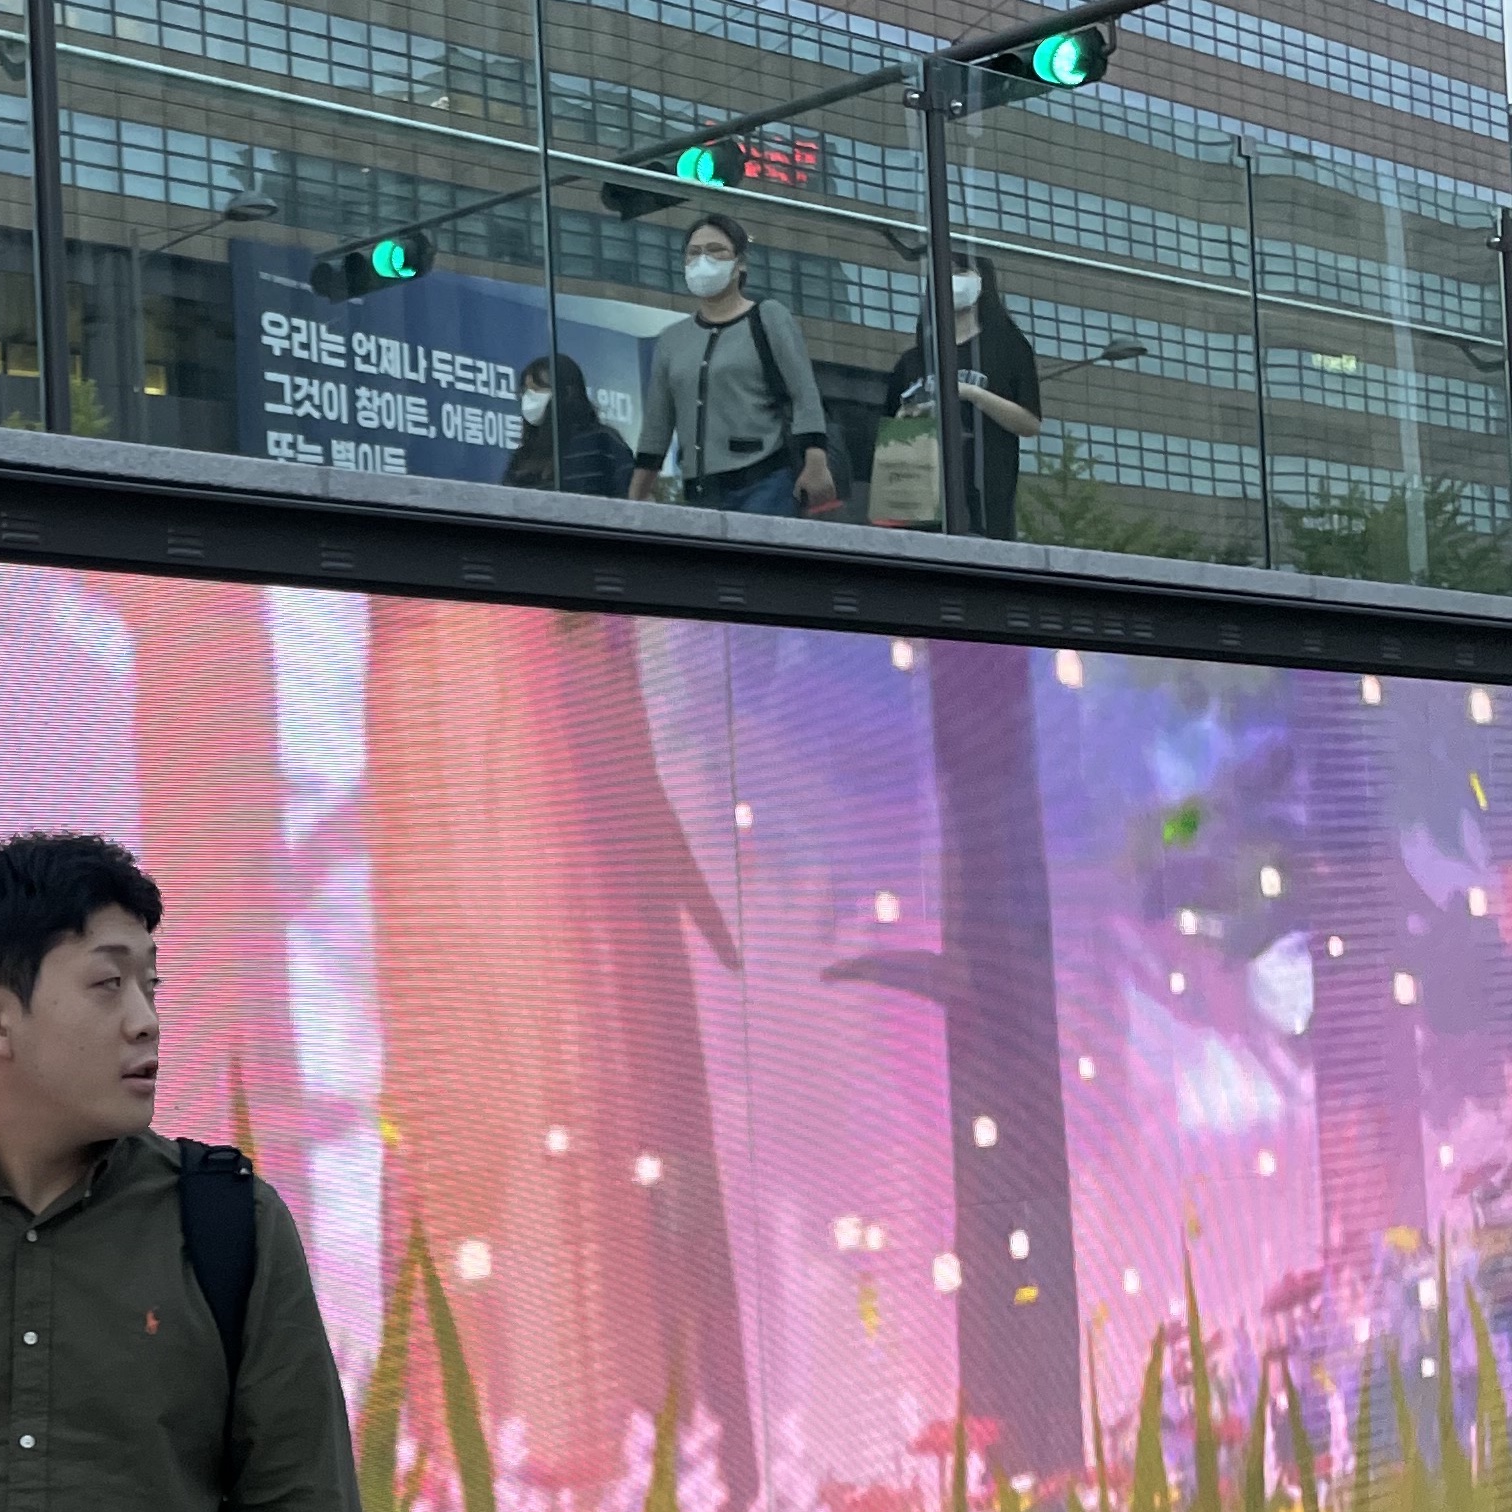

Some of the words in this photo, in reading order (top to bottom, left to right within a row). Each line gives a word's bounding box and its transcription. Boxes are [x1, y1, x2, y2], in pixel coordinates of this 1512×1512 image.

[261, 311, 347, 368] 우리는
[351, 331, 426, 384] 언제나
[431, 349, 517, 400] 두드리고
[264, 371, 348, 424] 그것이
[354, 385, 437, 439] 창이든,
[441, 402, 523, 450] 어둠이든
